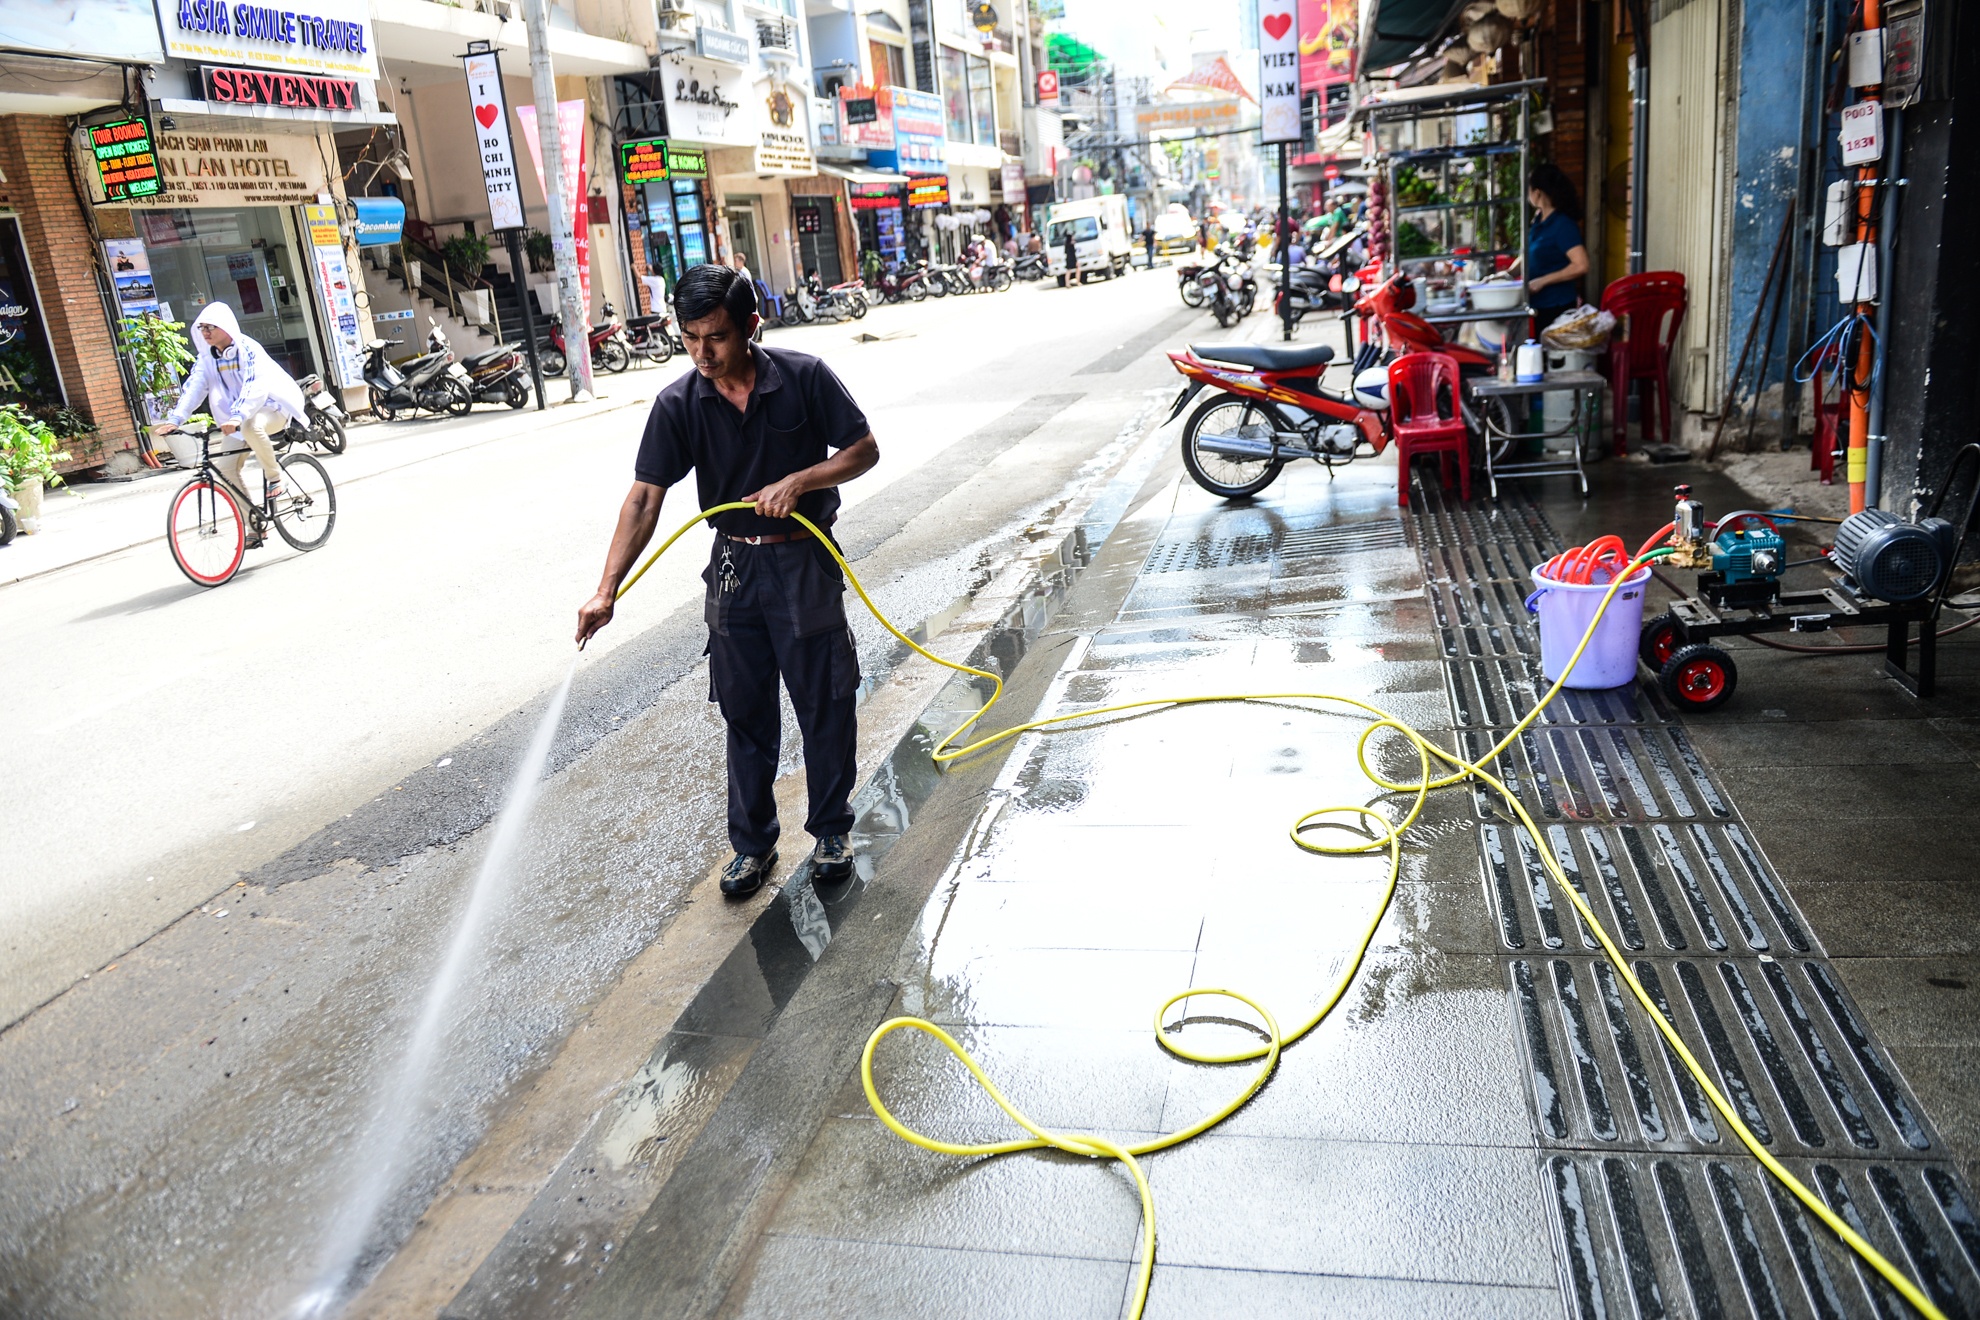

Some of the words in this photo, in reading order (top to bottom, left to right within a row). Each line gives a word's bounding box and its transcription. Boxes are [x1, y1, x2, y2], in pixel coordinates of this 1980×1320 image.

[178, 0, 231, 35] ASIA
[236, 3, 297, 44] SMILE
[300, 15, 367, 54] TRAVEL
[1263, 52, 1296, 69] VIET
[211, 68, 356, 110] SEVENTY
[479, 84, 485, 96] I
[1265, 82, 1296, 98] NAM
[697, 110, 720, 122] HOTEL
[1844, 105, 1874, 121] P003
[92, 129, 113, 145] TOUR
[112, 122, 146, 142] BOOKING
[96, 146, 114, 159] OPEN
[112, 143, 126, 156] BUS
[124, 139, 150, 154] TICKETS
[155, 131, 185, 151] HÁCH
[213, 137, 243, 153] PHAN
[245, 139, 269, 153] LAN
[484, 138, 499, 149] HO
[485, 153, 504, 163] CHI
[628, 154, 640, 164] AIR
[640, 152, 662, 162] TICKET
[182, 157, 227, 177] LAN
[231, 158, 298, 178] HOTEL
[484, 167, 511, 180] MINH
[627, 171, 641, 180] VISA
[128, 180, 158, 194] WELCOME
[278, 182, 307, 190] VIETNAM
[488, 182, 512, 194] CITY
[178, 195, 199, 203] 9855
[358, 219, 402, 234] Sacombank
[320, 261, 334, 298] Information
[0, 303, 24, 317] aigon
[328, 298, 337, 321] Tourist
